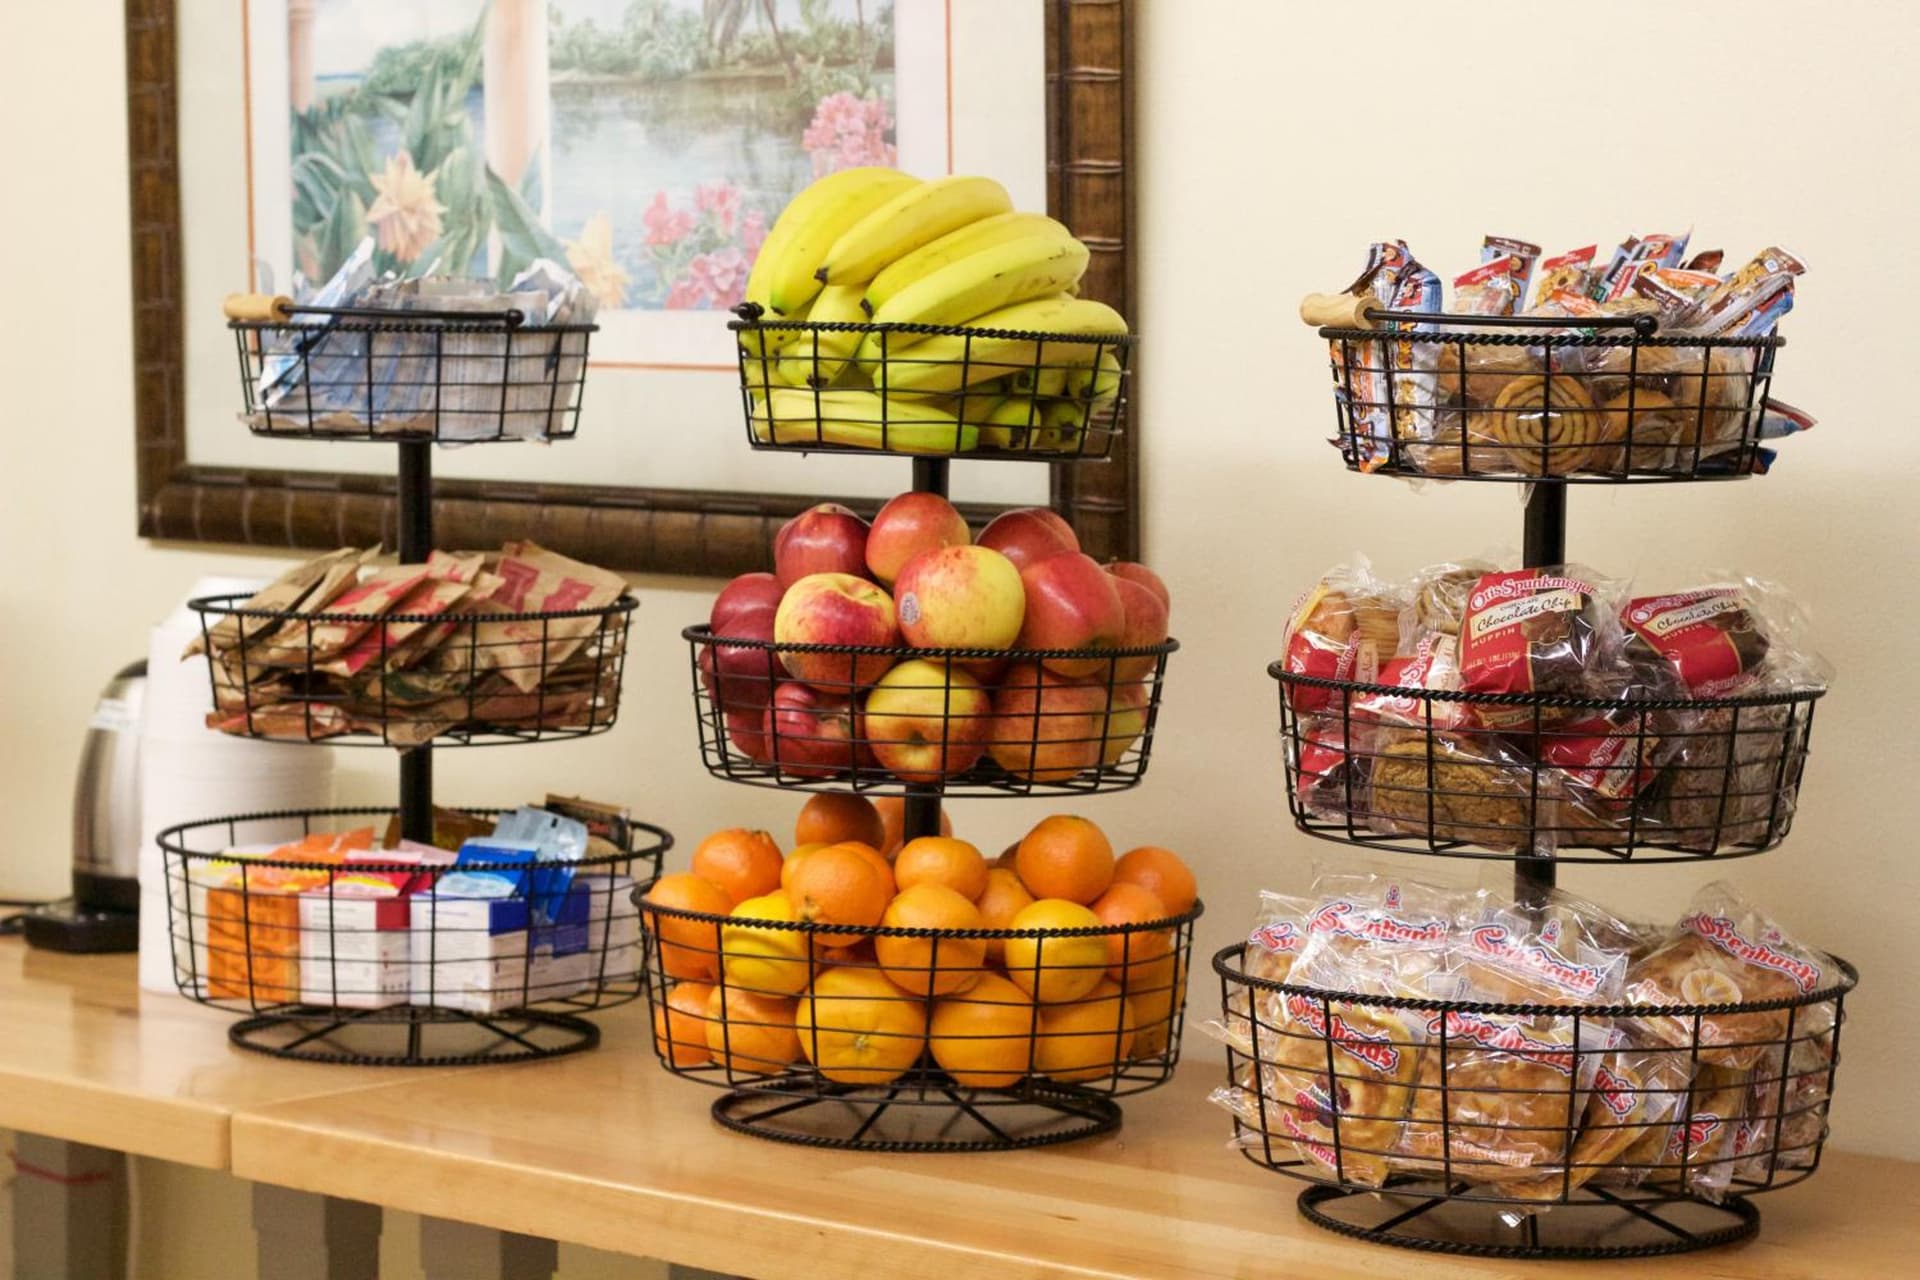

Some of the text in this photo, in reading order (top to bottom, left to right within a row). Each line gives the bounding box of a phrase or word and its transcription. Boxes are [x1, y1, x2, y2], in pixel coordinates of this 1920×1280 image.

[1471, 585, 1504, 611] Otis
[1501, 575, 1597, 598] Spunkmeyer
[1477, 603, 1541, 632] Chocolate
[1541, 596, 1572, 611] Chip
[1471, 627, 1515, 649] MUFFIN
[1681, 914, 1820, 994] Svenhard's
